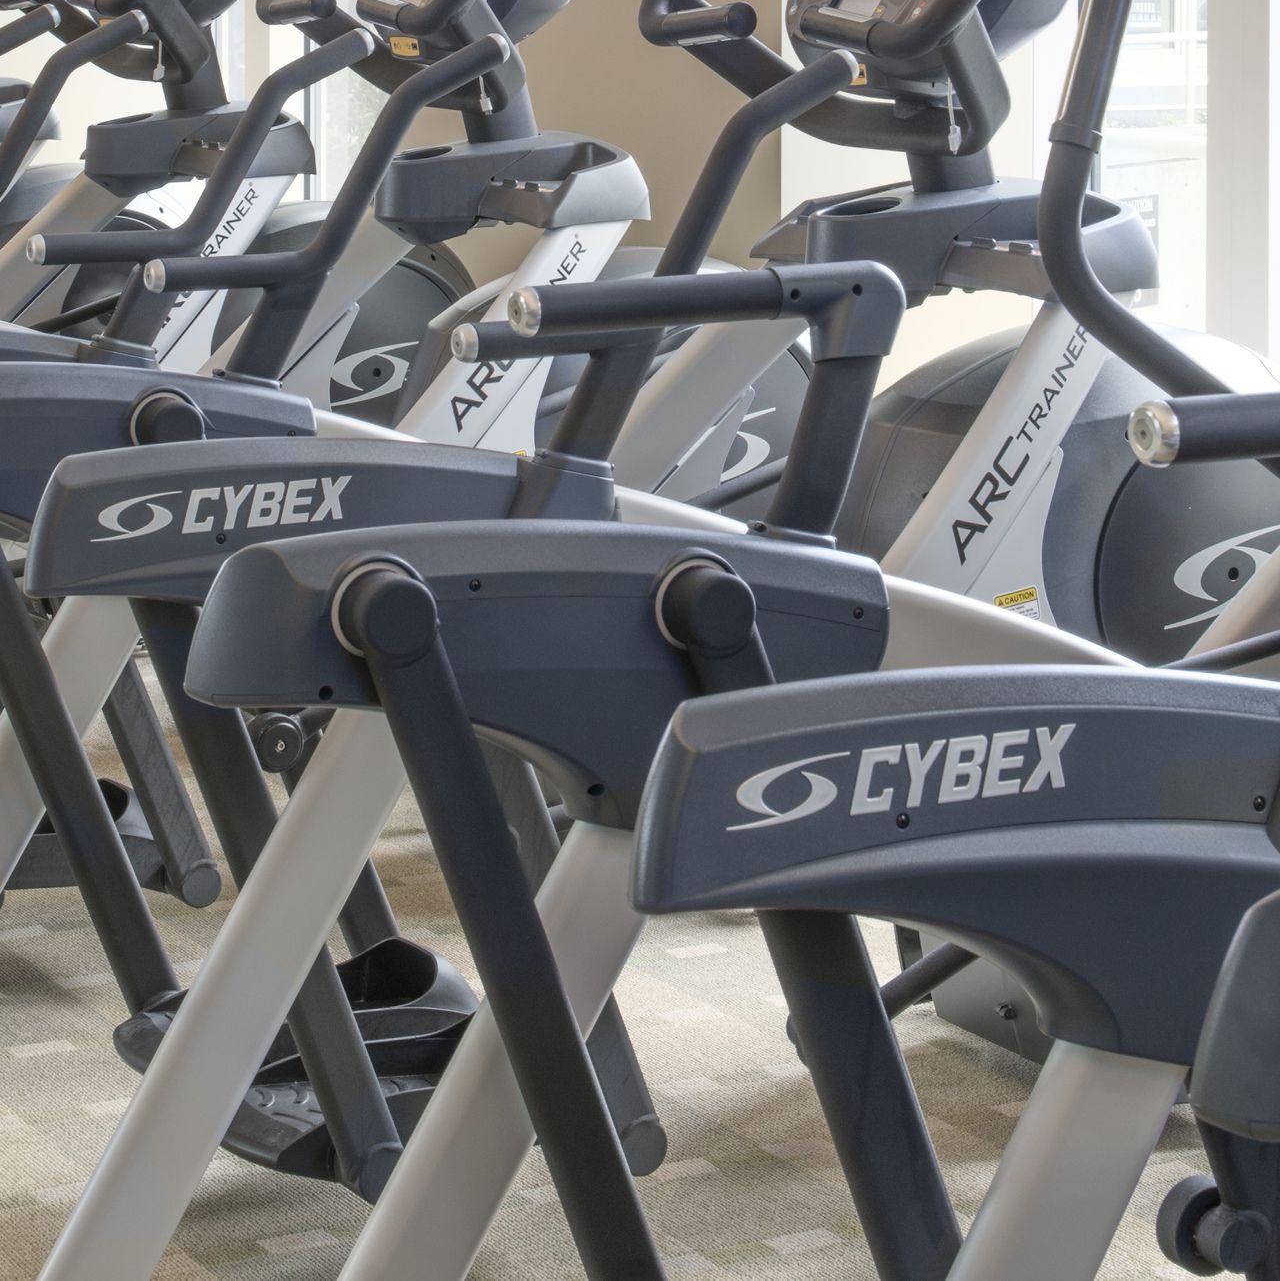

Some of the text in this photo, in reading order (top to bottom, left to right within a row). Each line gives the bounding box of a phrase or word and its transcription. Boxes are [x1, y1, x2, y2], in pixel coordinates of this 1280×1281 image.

[181, 475, 352, 534] CYBEX
[1004, 590, 1035, 605] CAUTION
[849, 723, 1077, 816] CYBEX
